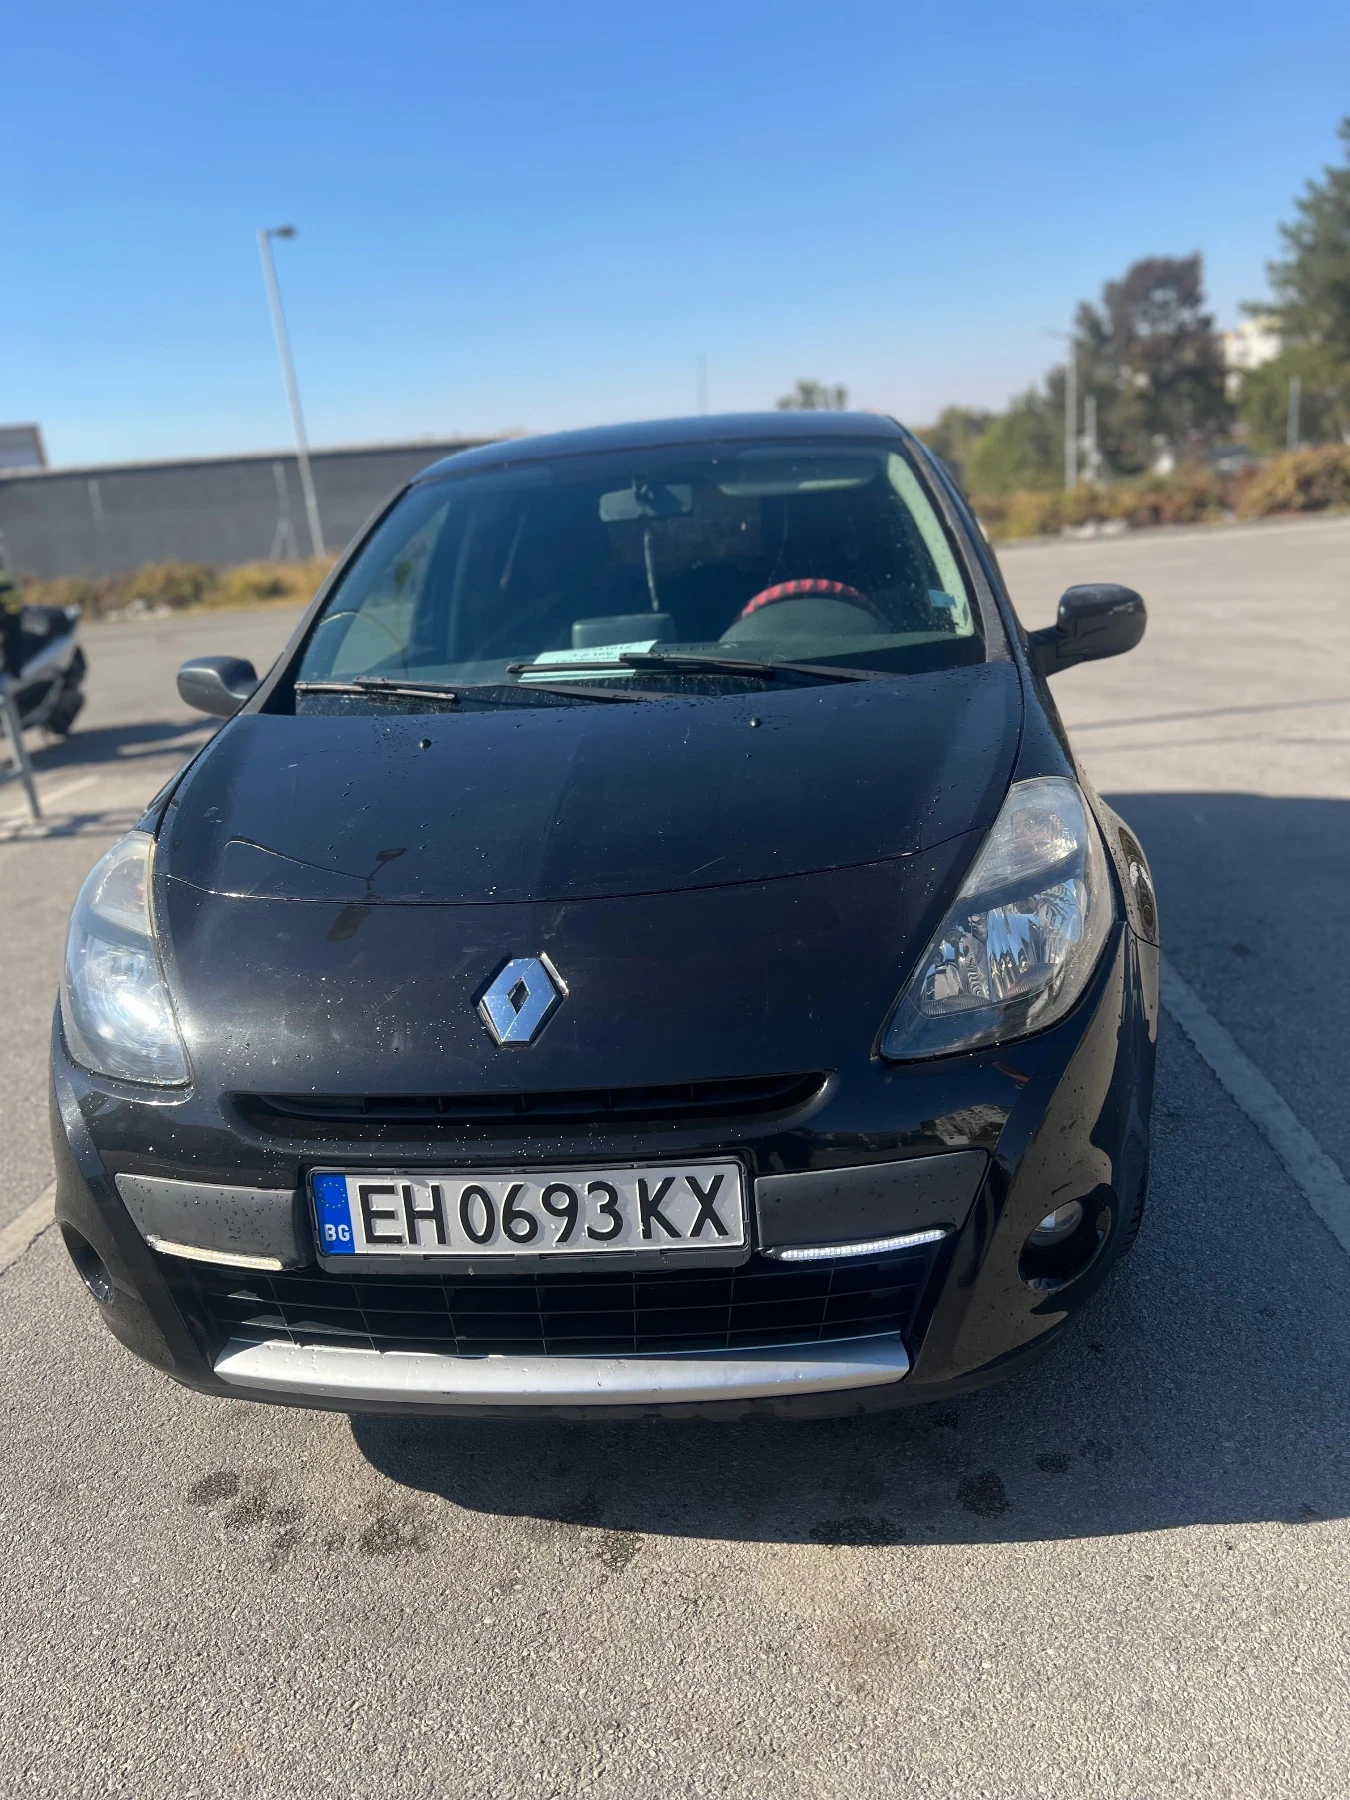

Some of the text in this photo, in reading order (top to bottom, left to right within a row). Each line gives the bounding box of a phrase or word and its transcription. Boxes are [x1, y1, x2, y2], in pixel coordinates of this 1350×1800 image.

[358, 1174, 730, 1245] EH 0693 KX
[324, 1223, 350, 1242] BG
